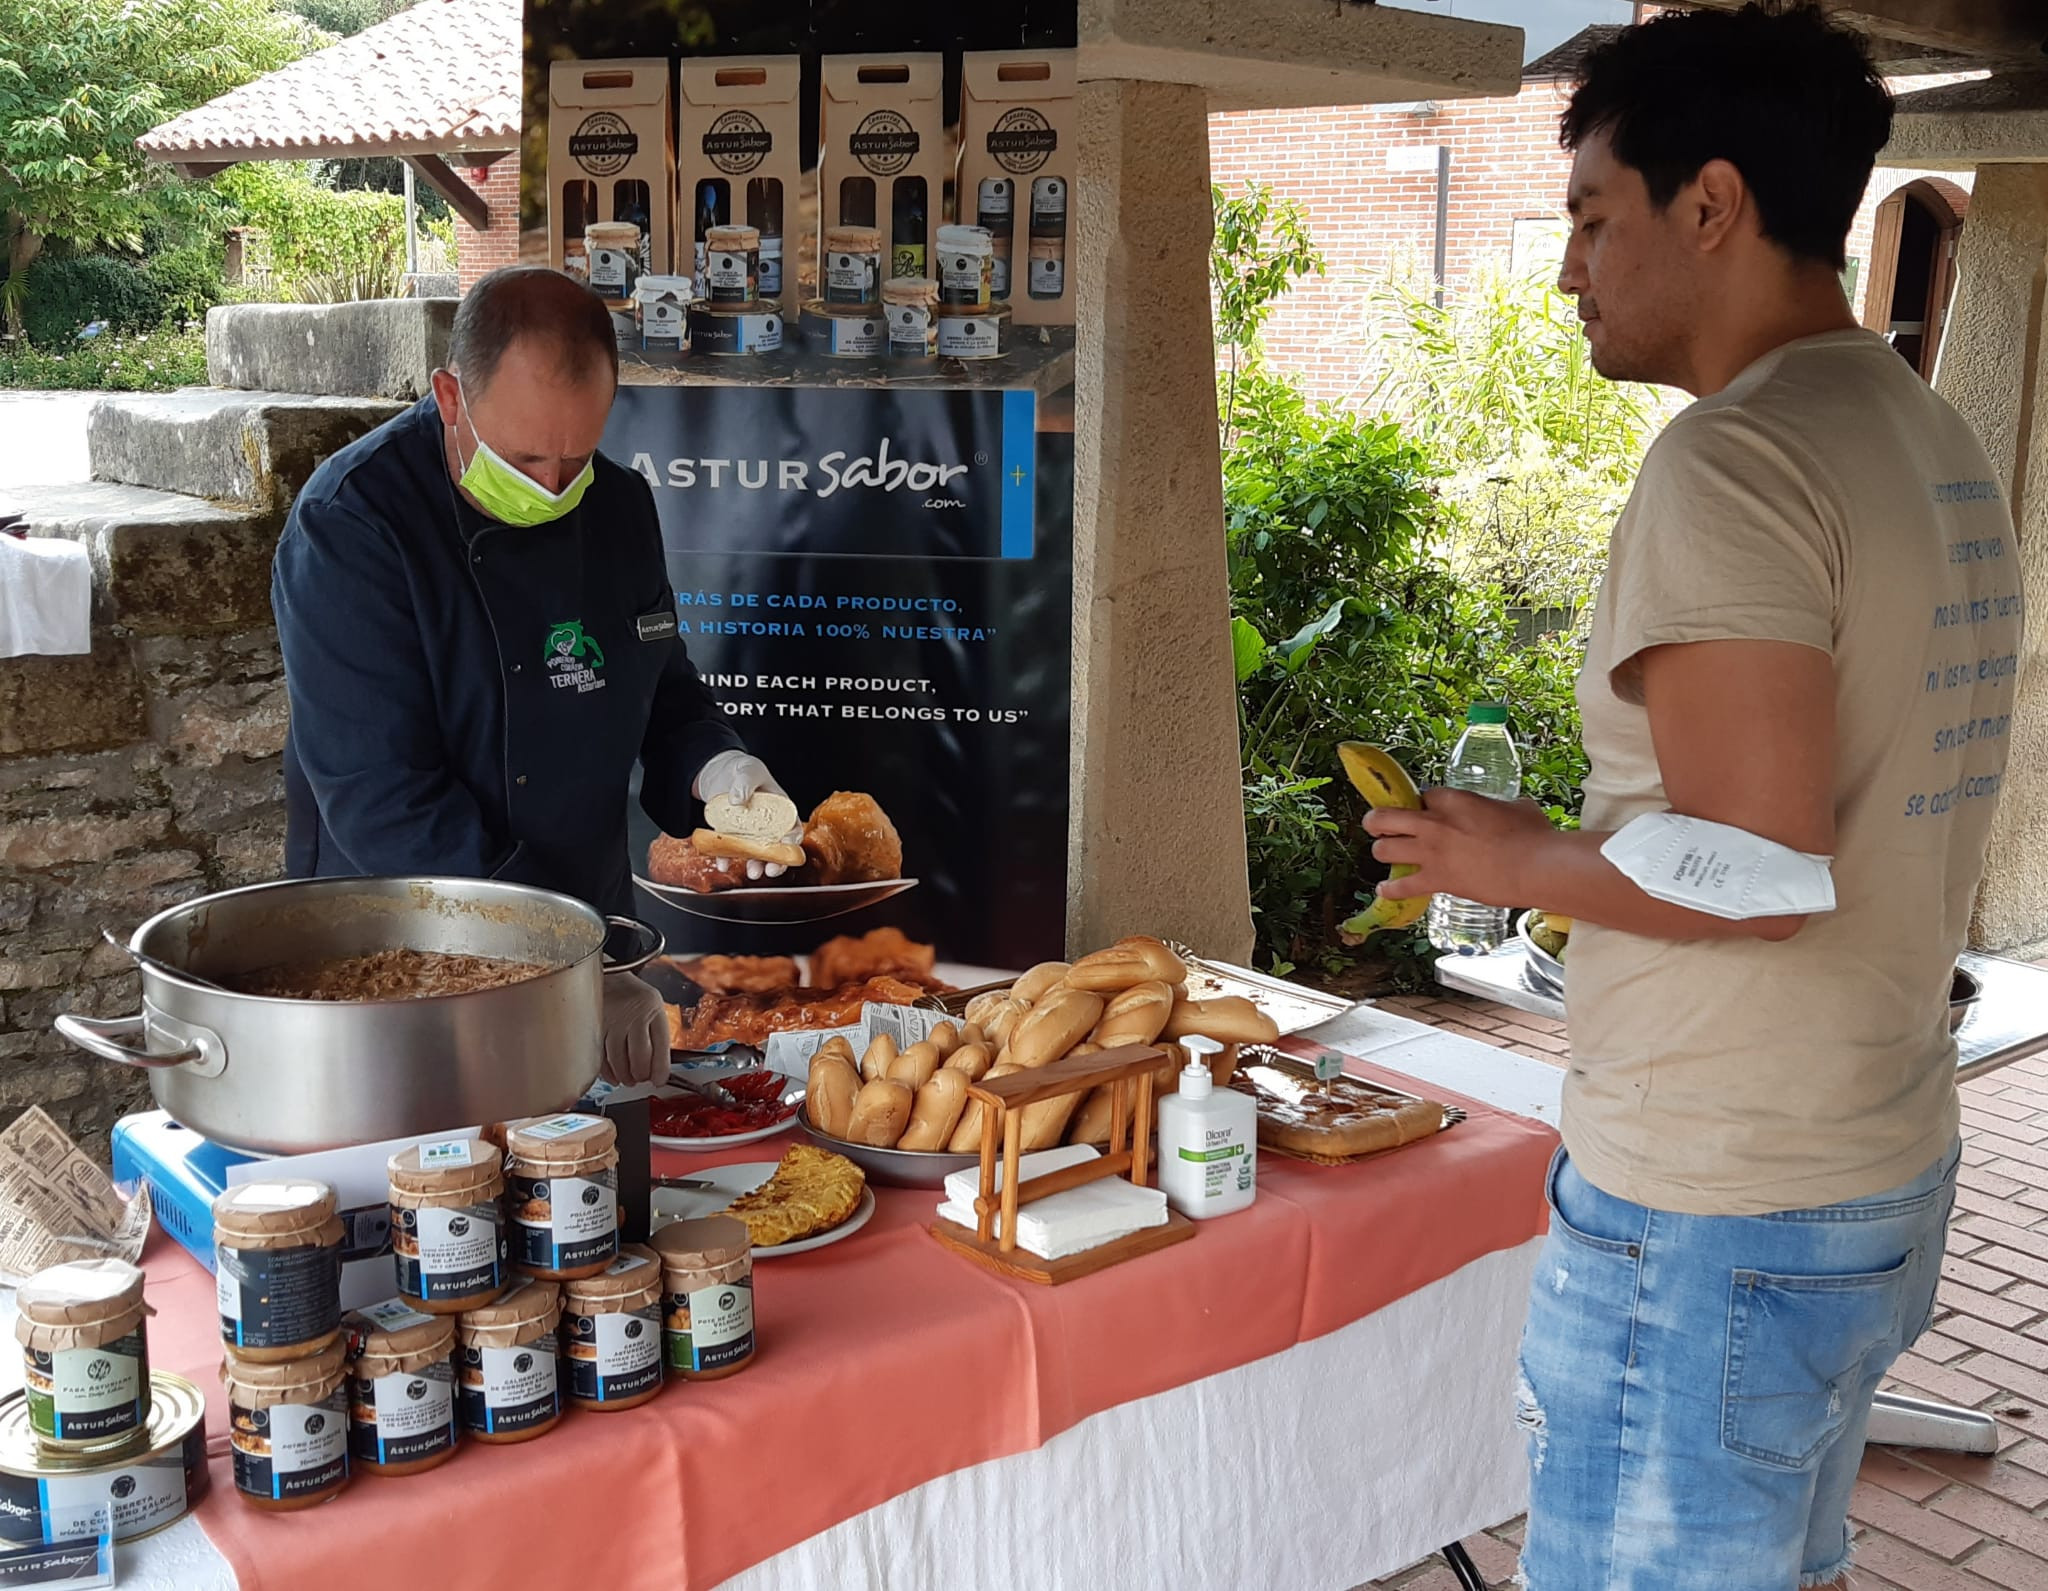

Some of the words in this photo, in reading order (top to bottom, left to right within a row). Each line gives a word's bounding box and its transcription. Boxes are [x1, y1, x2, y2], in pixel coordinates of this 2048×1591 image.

[731, 594, 759, 608] DE
[767, 594, 827, 609] CADA
[837, 596, 964, 615] PRODUCTO,
[701, 621, 804, 636] HISTORIA
[815, 624, 870, 640] 100%
[550, 668, 596, 688] TERNERA
[756, 675, 817, 690] EACH
[825, 677, 936, 695] PRODUCT,
[775, 704, 833, 719] THAT
[842, 705, 946, 721] BELONGS
[953, 709, 980, 723] TO
[0, 1498, 32, 1516] abor
